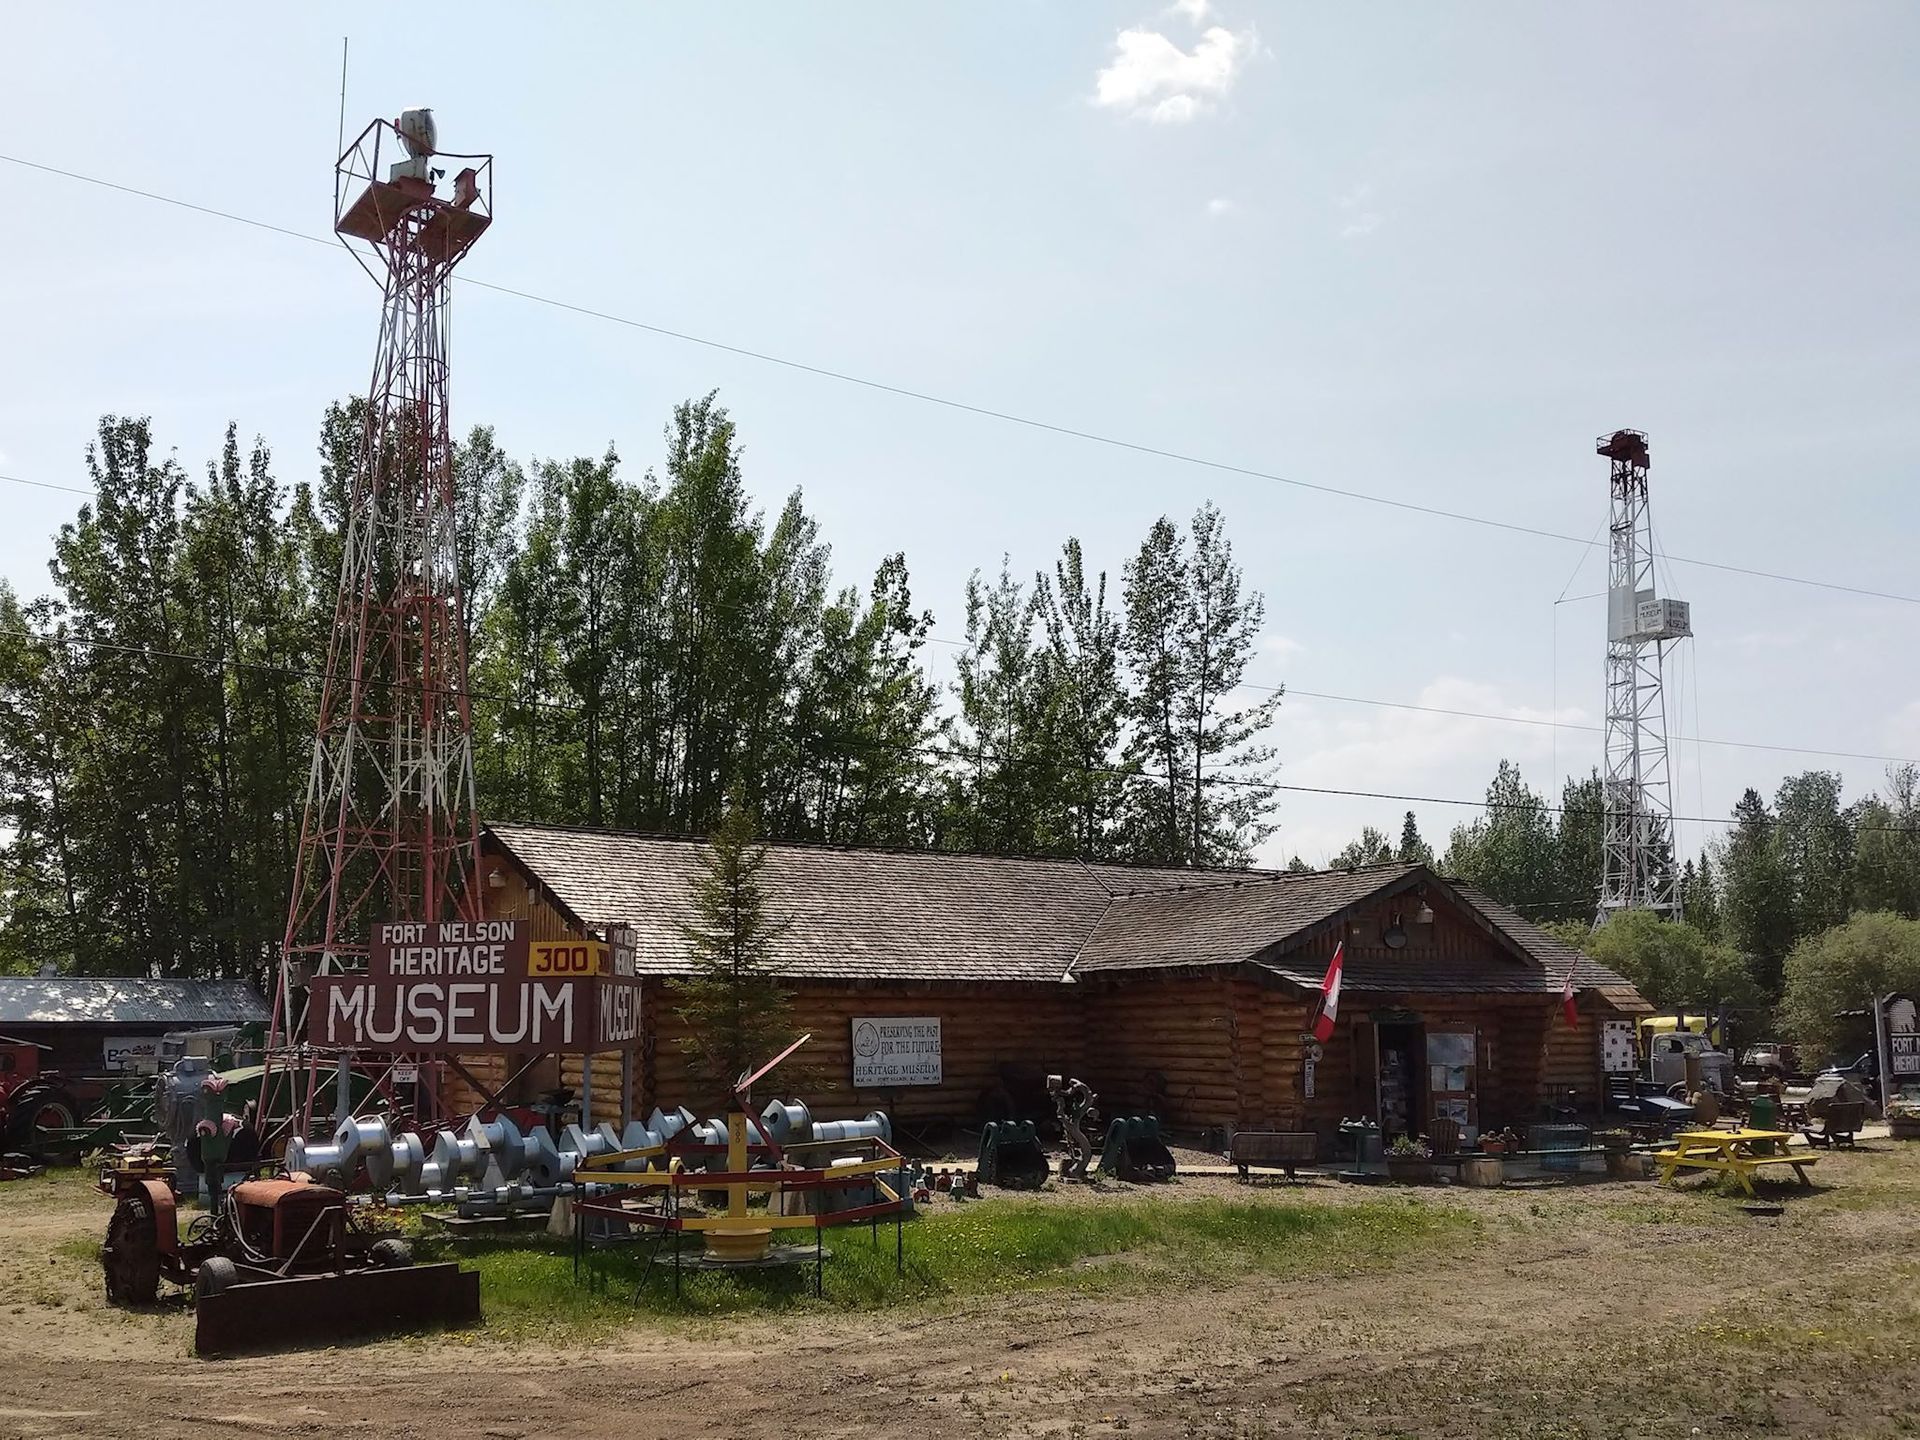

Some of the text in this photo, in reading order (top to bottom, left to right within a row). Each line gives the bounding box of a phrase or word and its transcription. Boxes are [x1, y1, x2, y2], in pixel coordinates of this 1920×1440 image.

[381, 921, 515, 945] FORT NELSON
[389, 944, 505, 975] HERITAGE
[536, 947, 589, 972] 300
[327, 982, 574, 1044] MUSEUM
[600, 983, 642, 1042] MUSEUM
[914, 1026, 925, 1038] THE
[927, 1026, 939, 1037] PAST
[881, 1041, 940, 1055] FOR THE FUTURE
[1892, 1037, 1914, 1053] FORT
[855, 1064, 939, 1076] HERITAGE MUSEUM
